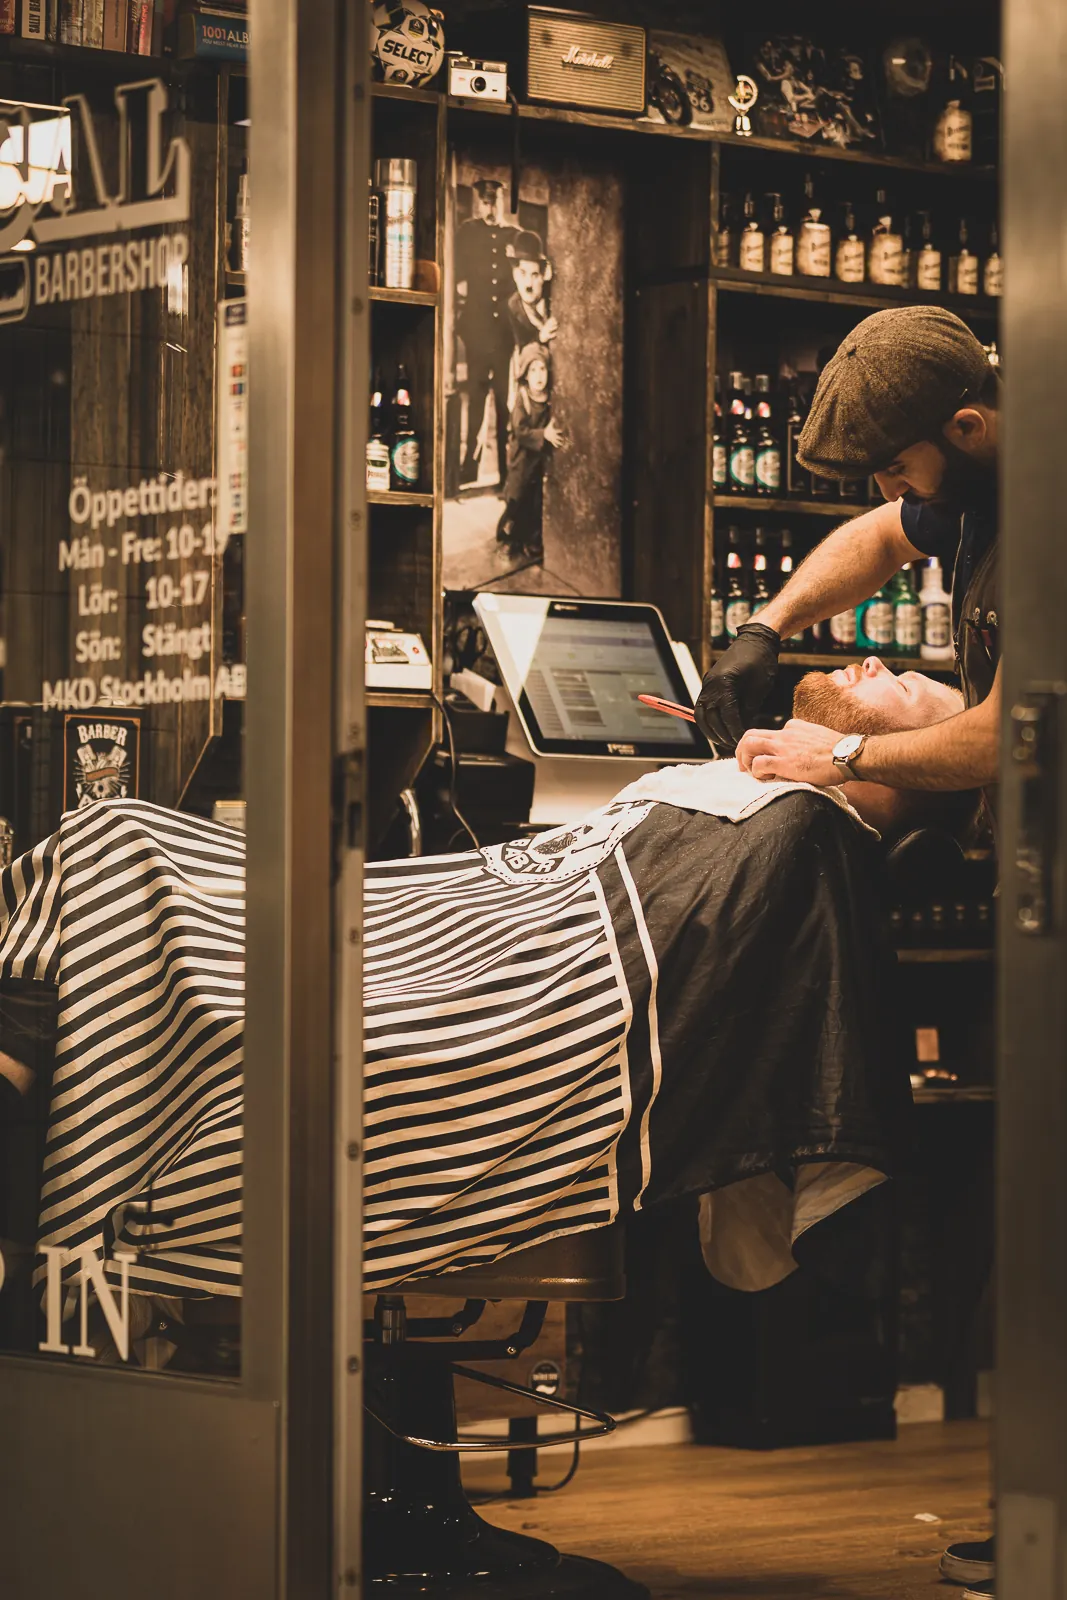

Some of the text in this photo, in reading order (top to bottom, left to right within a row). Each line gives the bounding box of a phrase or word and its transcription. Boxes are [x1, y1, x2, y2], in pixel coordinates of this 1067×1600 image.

[28, 14, 41, 34] SALLY
[202, 25, 227, 40] 1001
[382, 39, 433, 67] SELECT
[561, 45, 615, 69] Marshall
[35, 233, 189, 304] BARBERSHOP
[69, 471, 218, 530] Öppettider:
[58, 535, 105, 572] Mån
[122, 531, 162, 565] Fre:
[78, 571, 210, 616] Lör: 10-17
[75, 621, 212, 663] Sön: Stängt
[42, 677, 97, 712] MKD
[100, 667, 211, 707] Stockholm
[77, 723, 128, 746] BARBER
[38, 1245, 138, 1362] IN
